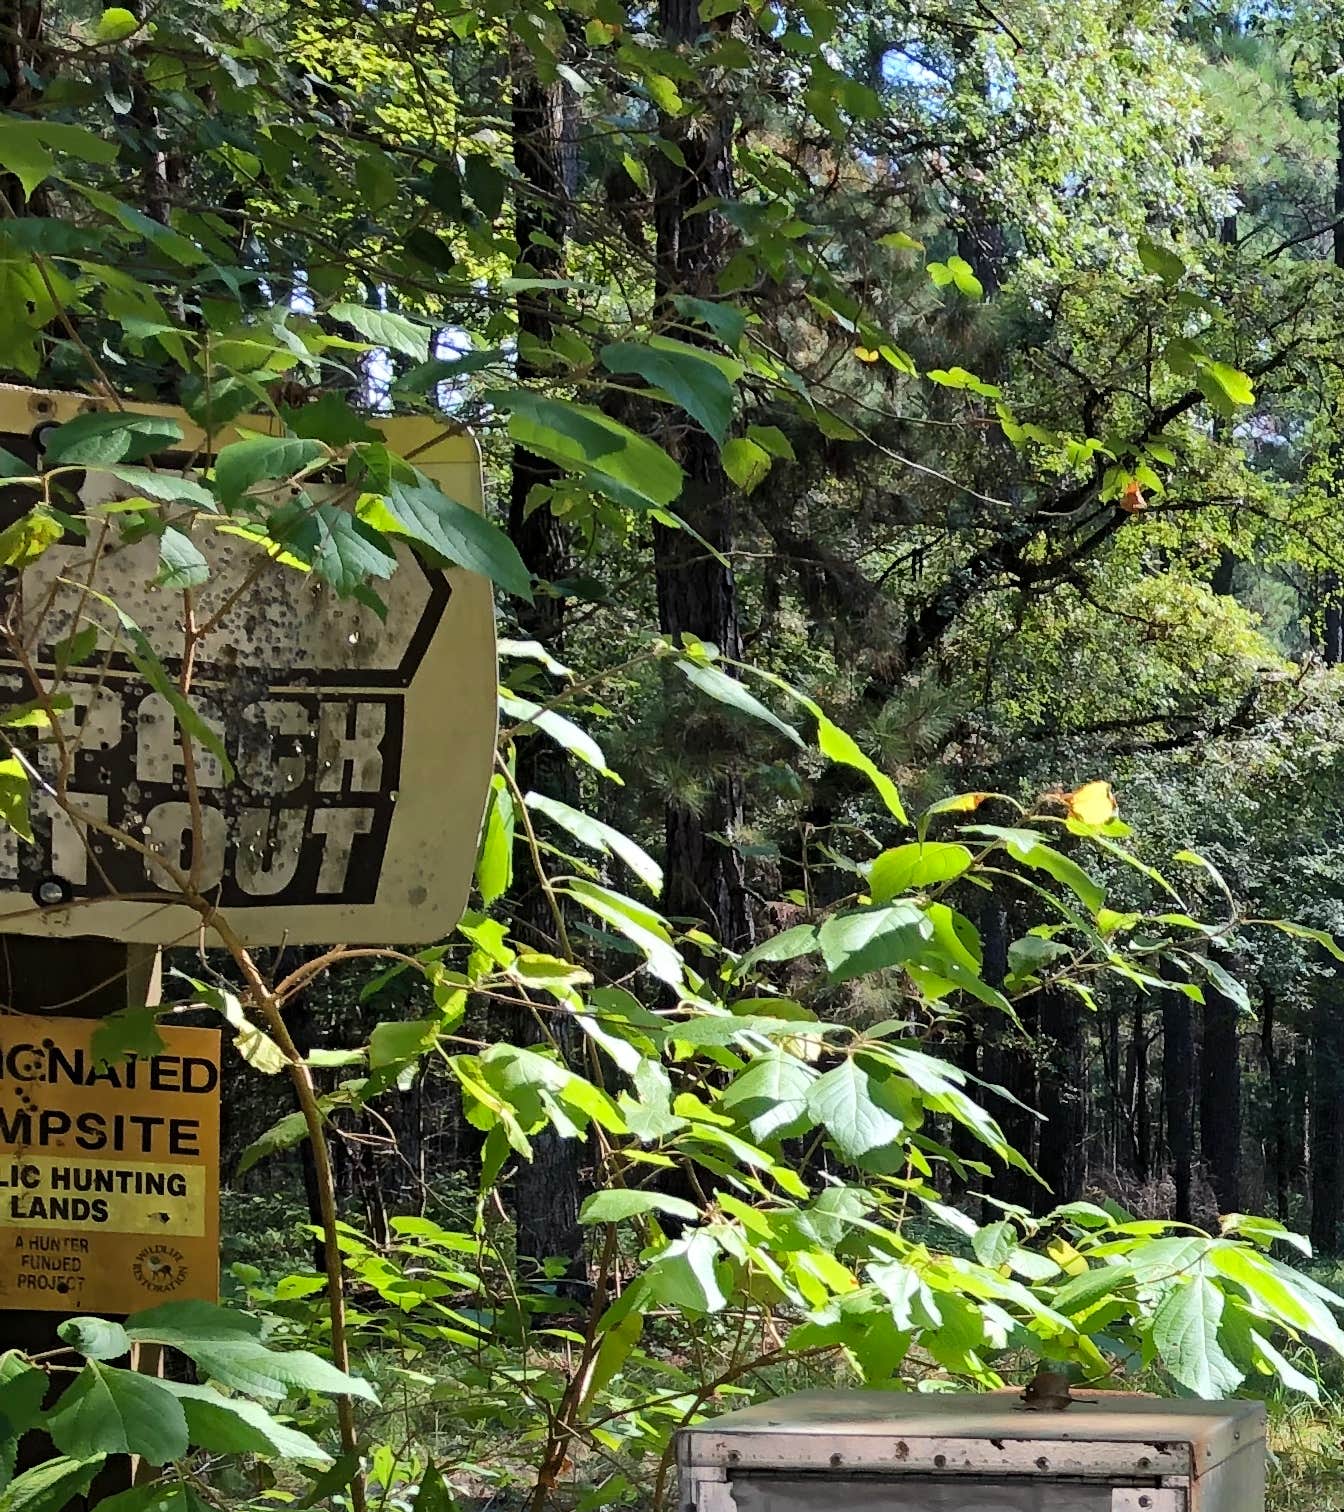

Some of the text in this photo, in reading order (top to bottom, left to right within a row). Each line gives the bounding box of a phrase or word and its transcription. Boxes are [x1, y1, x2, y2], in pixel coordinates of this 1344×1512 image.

[144, 801, 375, 896] OUT
[51, 1166, 187, 1197] HUNTING
[11, 1195, 109, 1223] LANDS
[15, 1235, 89, 1253] A HUNTER
[21, 1254, 81, 1272] FUNDED
[17, 1274, 86, 1291] PROJECT
